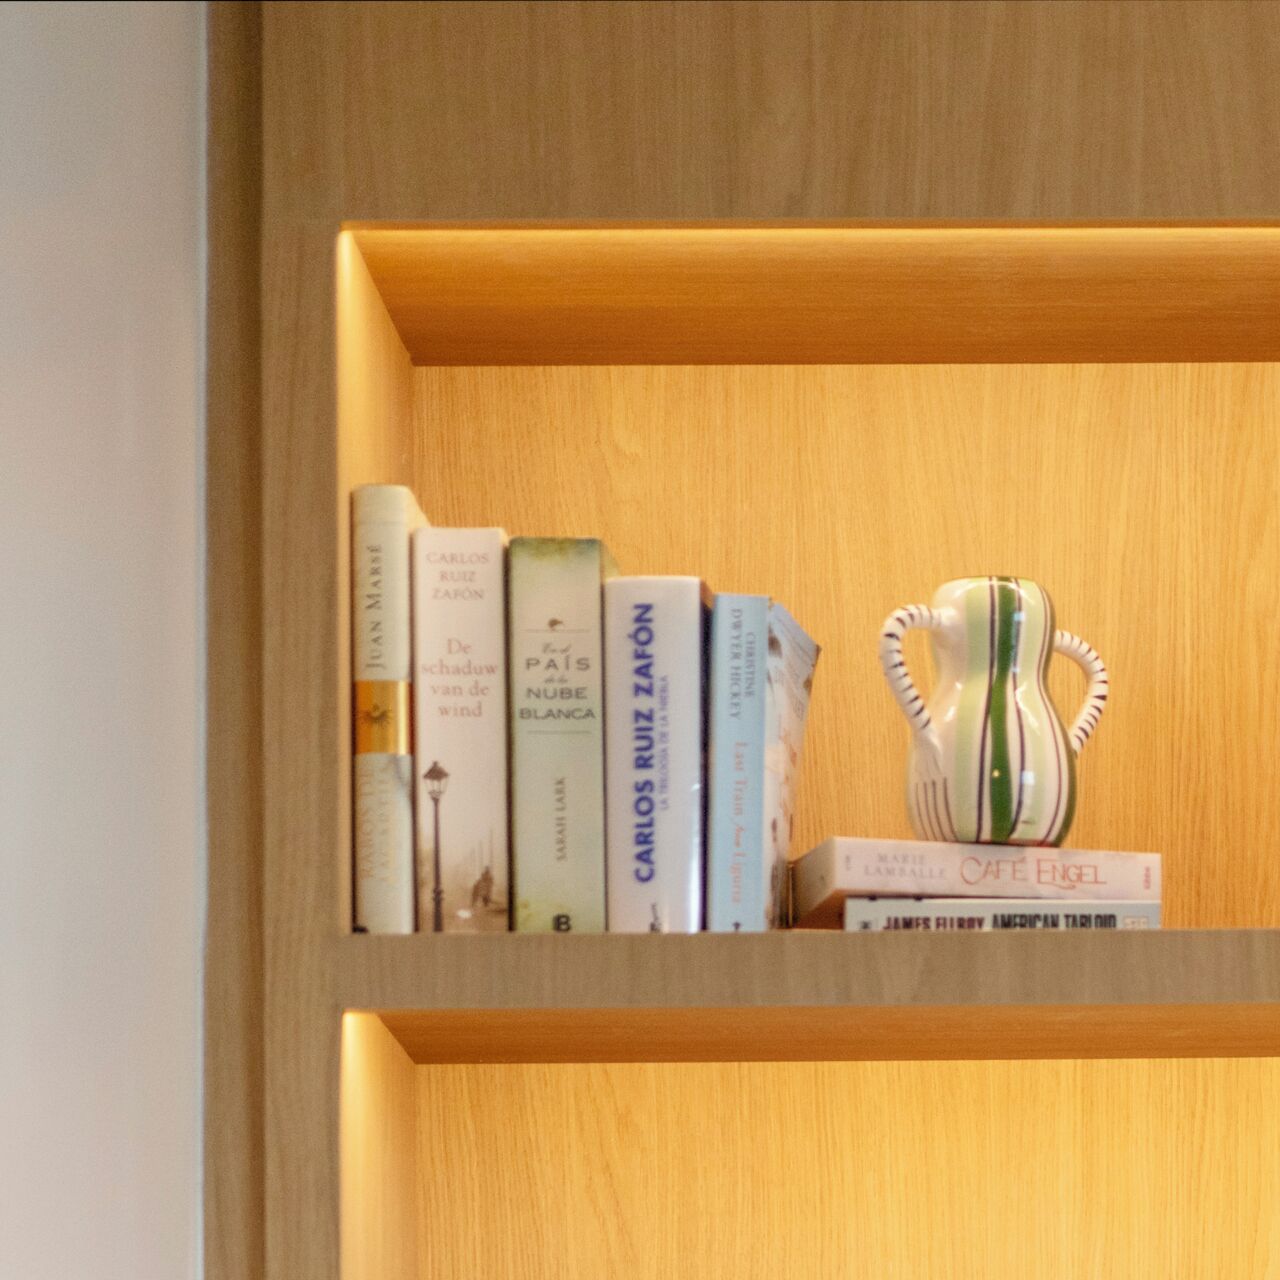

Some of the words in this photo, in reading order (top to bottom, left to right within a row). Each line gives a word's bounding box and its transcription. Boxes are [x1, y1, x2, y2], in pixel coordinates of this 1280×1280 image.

[426, 552, 489, 564] CARLOS
[366, 545, 382, 610] MARSÉ
[432, 587, 484, 600] ZAFÓN
[440, 571, 476, 582] RUIZ
[366, 621, 385, 669] JUAN
[447, 639, 472, 654] De
[627, 603, 655, 697] ZAFÓN
[730, 609, 743, 660] DWYER
[421, 659, 498, 675] schaduw
[525, 655, 591, 671] PAÍS
[745, 632, 756, 697] CHRISTINE
[431, 685, 463, 696] van
[469, 680, 489, 696] de
[526, 687, 588, 700] NUBE
[729, 666, 742, 720] HICKEY
[438, 702, 483, 717] wind
[519, 708, 596, 720] BLANCA
[634, 708, 655, 769] RUIZ
[555, 777, 566, 812] LARK
[555, 816, 567, 861] SARAH
[633, 779, 655, 883] CARLOS
[959, 856, 1028, 886] CAFÉ
[1036, 858, 1107, 890] ENGEL
